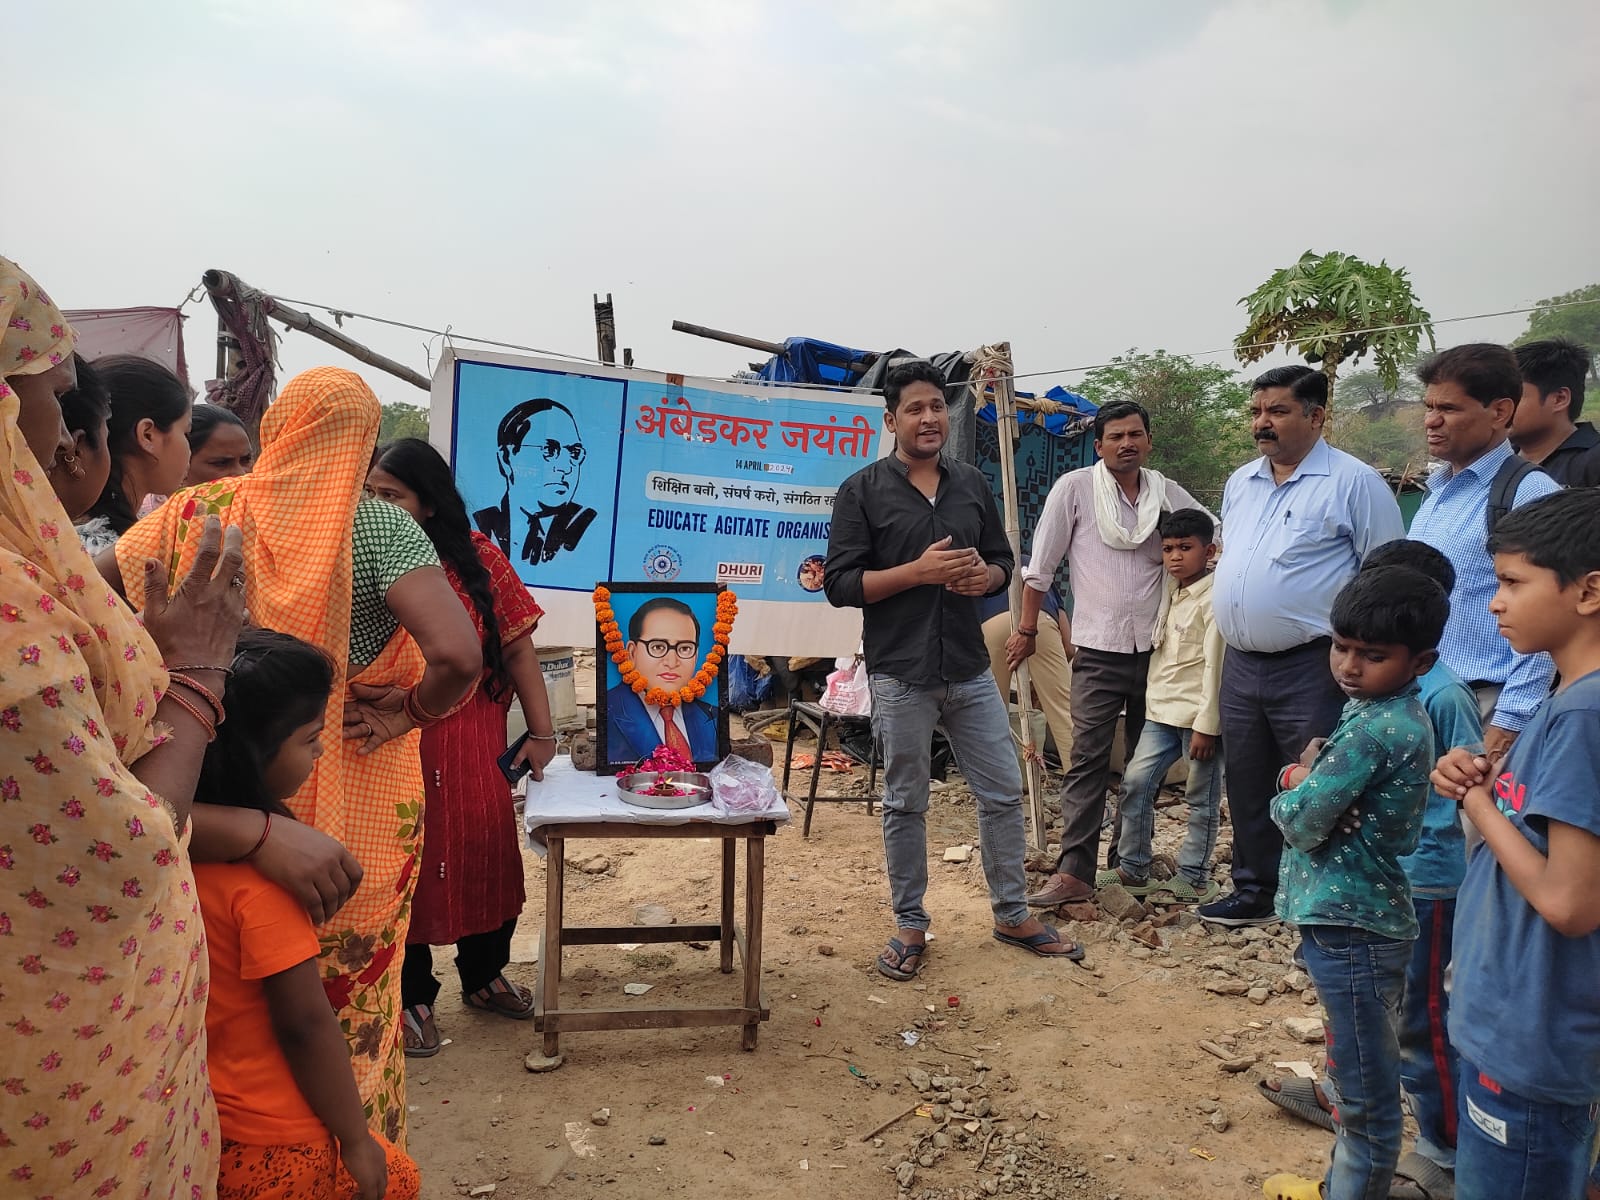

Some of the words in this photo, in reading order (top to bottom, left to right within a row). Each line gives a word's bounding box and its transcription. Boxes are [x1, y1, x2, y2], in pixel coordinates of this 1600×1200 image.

[635, 397, 773, 449] अंबेडकर
[780, 415, 876, 458] जयंती
[735, 459, 743, 470] 14
[743, 459, 762, 472] APRIL
[652, 476, 690, 494] शिक्षित
[693, 480, 719, 499] बनो,
[722, 485, 752, 501] संघर्ष
[754, 488, 779, 507] करो,
[783, 490, 822, 507] संगठित
[648, 508, 708, 533] EDUCATE
[714, 515, 771, 539] AGITATE
[718, 563, 763, 576] DHURI
[546, 661, 569, 671] Dulux
